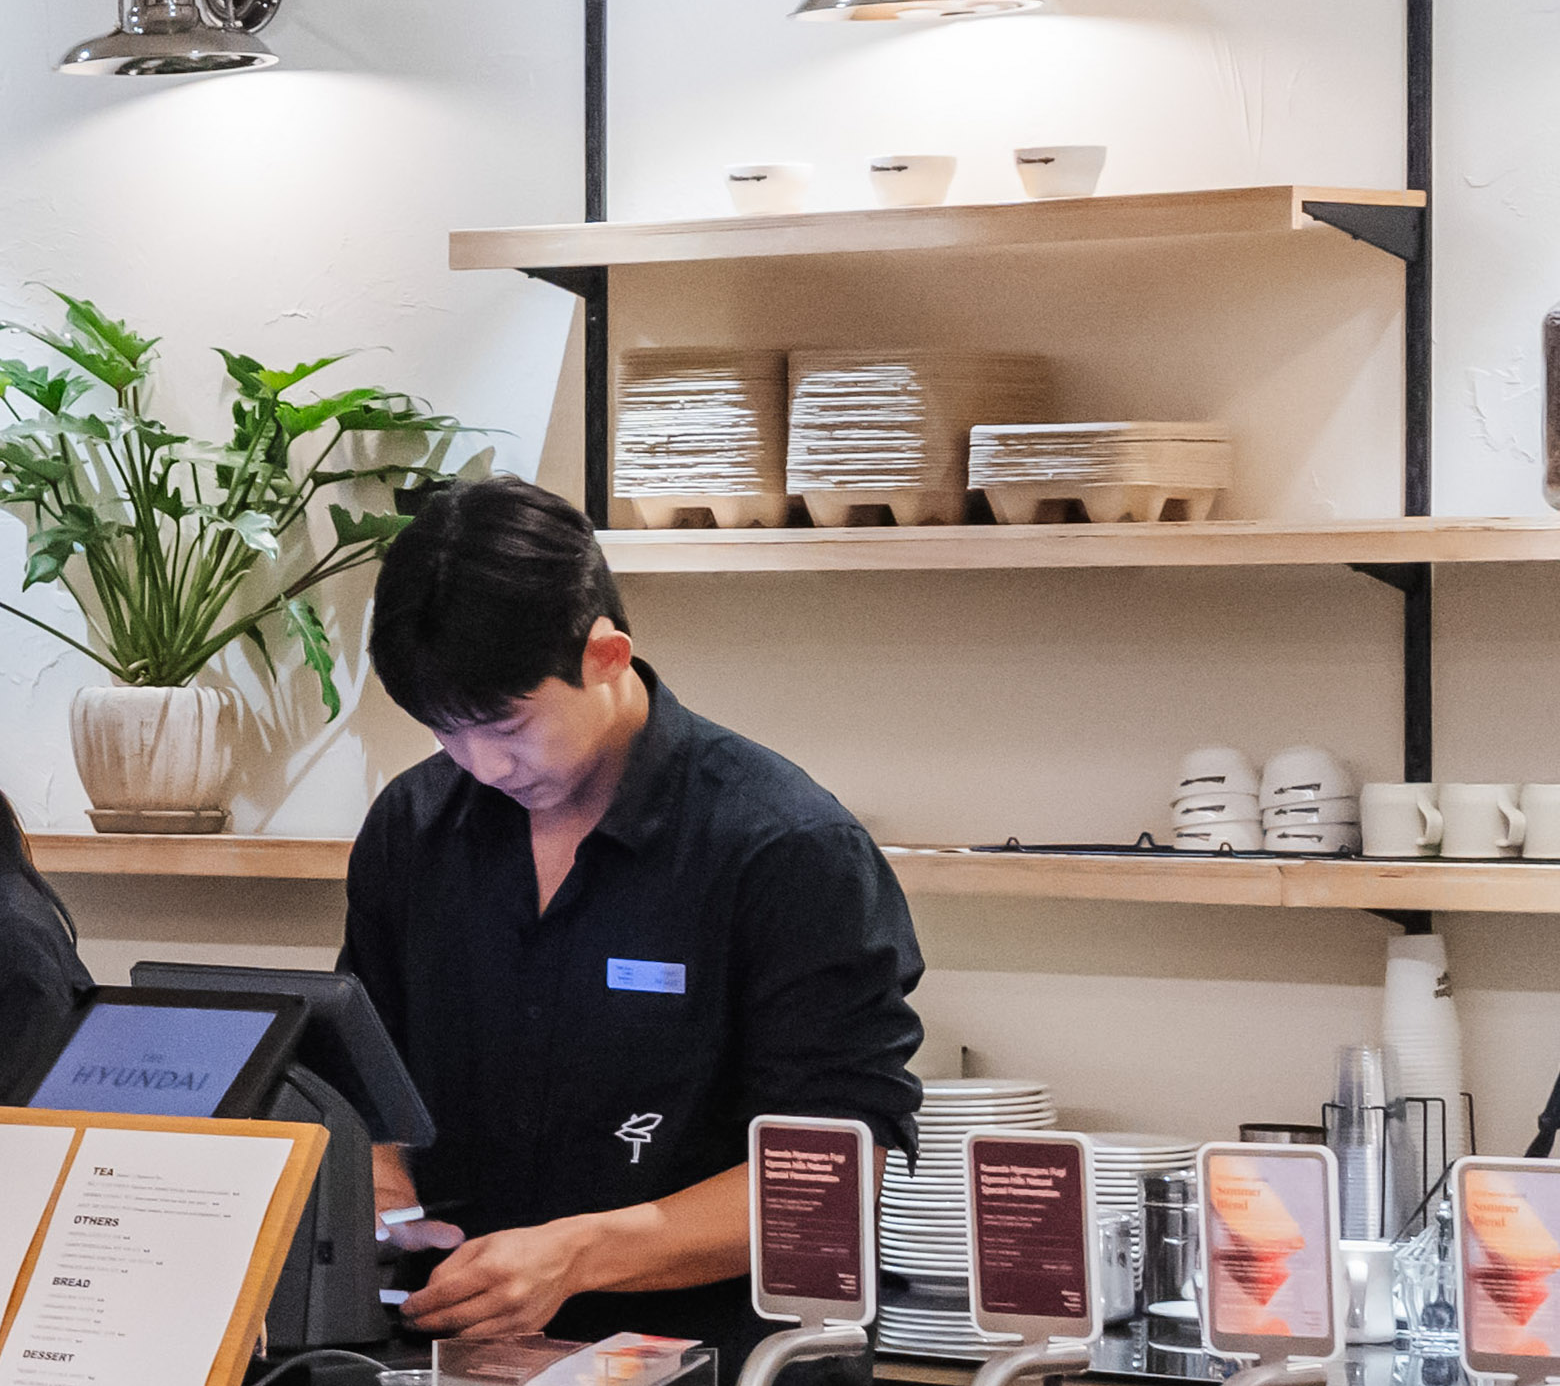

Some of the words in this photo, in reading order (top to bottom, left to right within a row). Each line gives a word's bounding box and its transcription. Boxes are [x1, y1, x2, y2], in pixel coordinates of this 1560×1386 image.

[72, 1066, 210, 1091] HYUNDAI
[92, 1166, 114, 1177] TEA
[73, 1215, 119, 1227] OTHERS
[51, 1276, 91, 1288] BREAD
[22, 1349, 75, 1363] DESSERT
